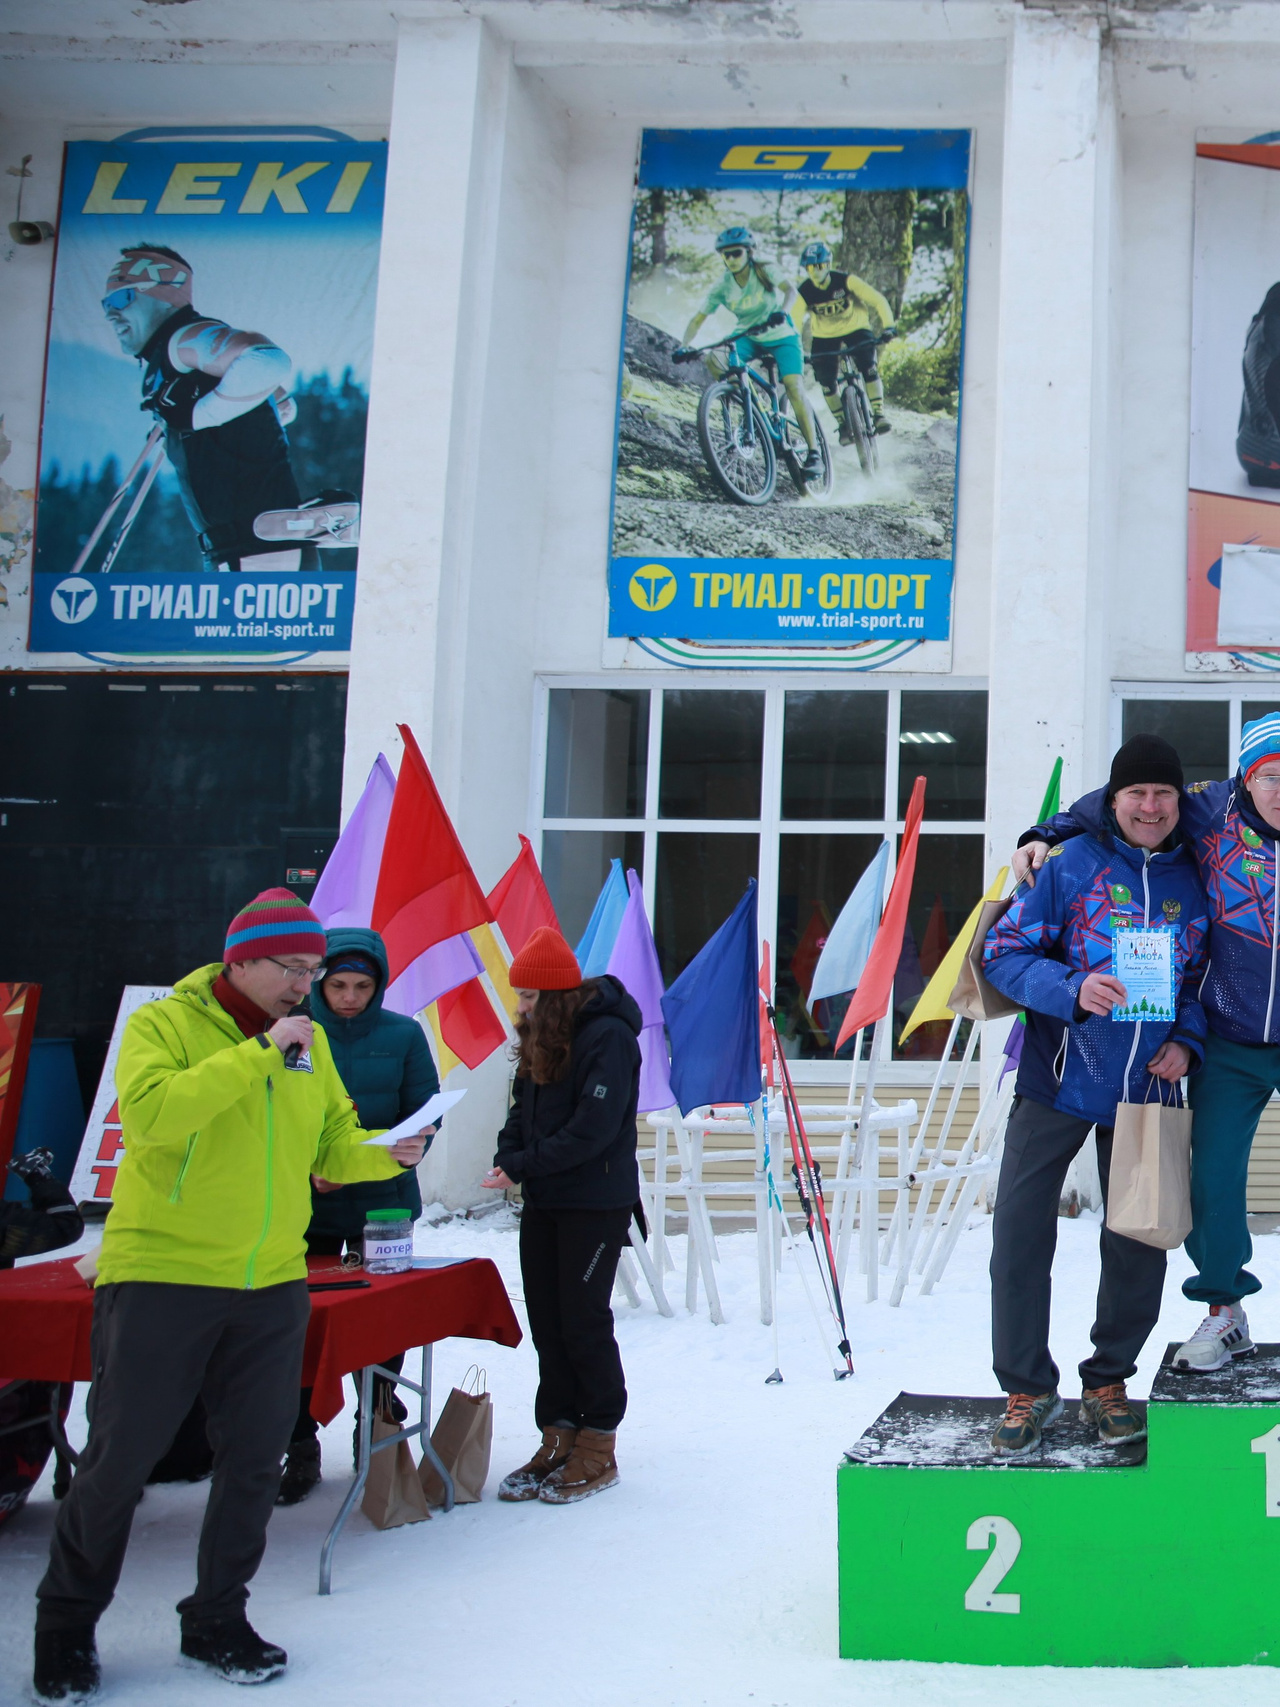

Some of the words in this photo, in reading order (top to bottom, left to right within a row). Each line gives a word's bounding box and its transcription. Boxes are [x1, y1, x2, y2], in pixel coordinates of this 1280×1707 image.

[720, 146, 904, 170] GT
[81, 161, 372, 215] LEKI
[783, 172, 857, 180] BICYCLES
[194, 622, 335, 640] www.trial-sport.ru
[778, 612, 924, 631] www.trial-sport.ru
[1245, 862, 1261, 873] SFR
[1123, 953, 1163, 961] ГРАМОТА
[798, 1168, 809, 1199] NORDWAY
[810, 1167, 821, 1198] NORDWAY
[583, 1242, 606, 1282] noname
[965, 1515, 1021, 1614] 2
